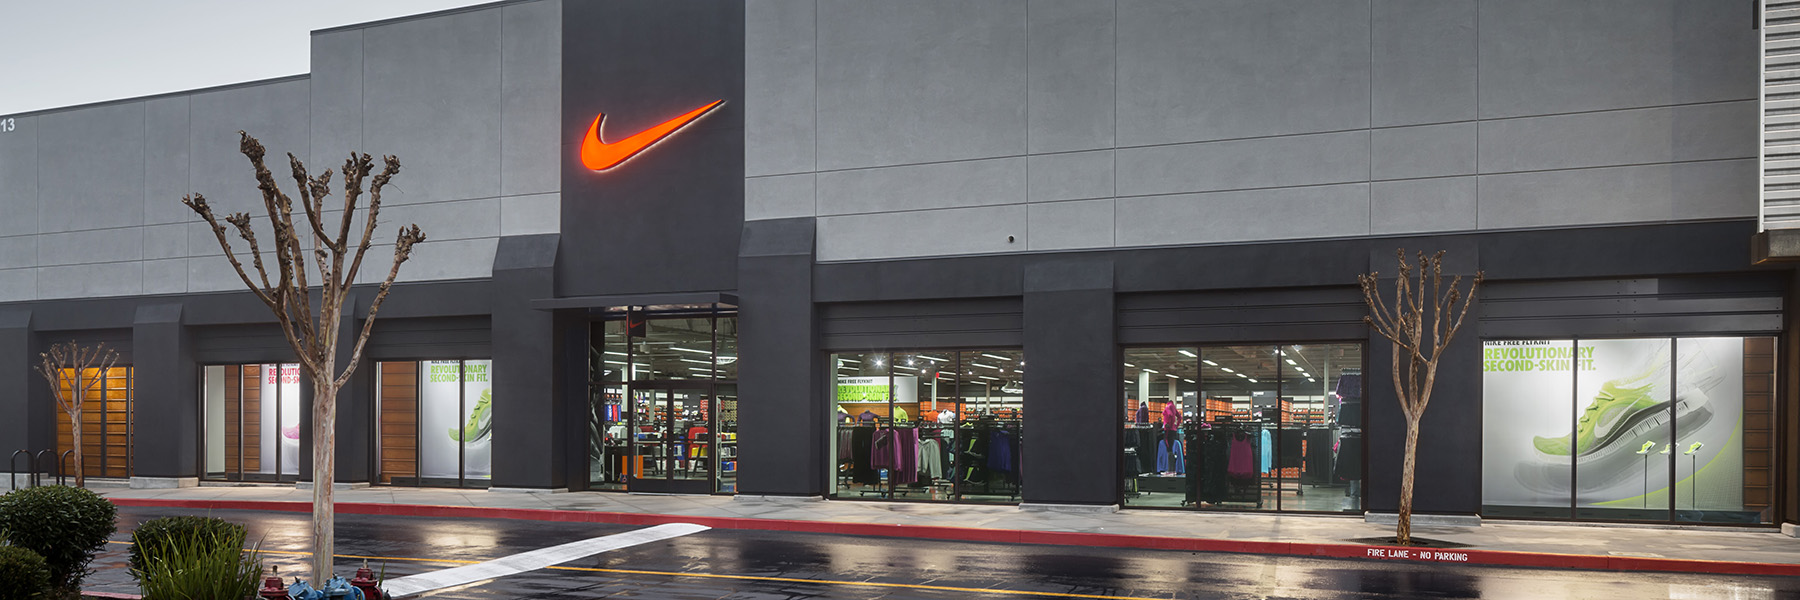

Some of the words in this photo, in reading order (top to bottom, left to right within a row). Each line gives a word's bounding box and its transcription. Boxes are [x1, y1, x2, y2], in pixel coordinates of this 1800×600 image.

[1484, 346, 1595, 359] REVOLUTIONARY
[430, 365, 487, 374] REVOLUTNARY
[1483, 359, 1570, 372] SECOND-SKIN
[1577, 359, 1597, 371] IT.
[269, 368, 300, 376] REOLUTI
[430, 374, 475, 382] SECOND-IN
[838, 385, 896, 393] REVOLUTIONAR
[1367, 548, 1385, 557] FIRE
[1388, 549, 1409, 558] LANE
[1420, 551, 1431, 560] NO
[1434, 552, 1468, 562] PARKING
